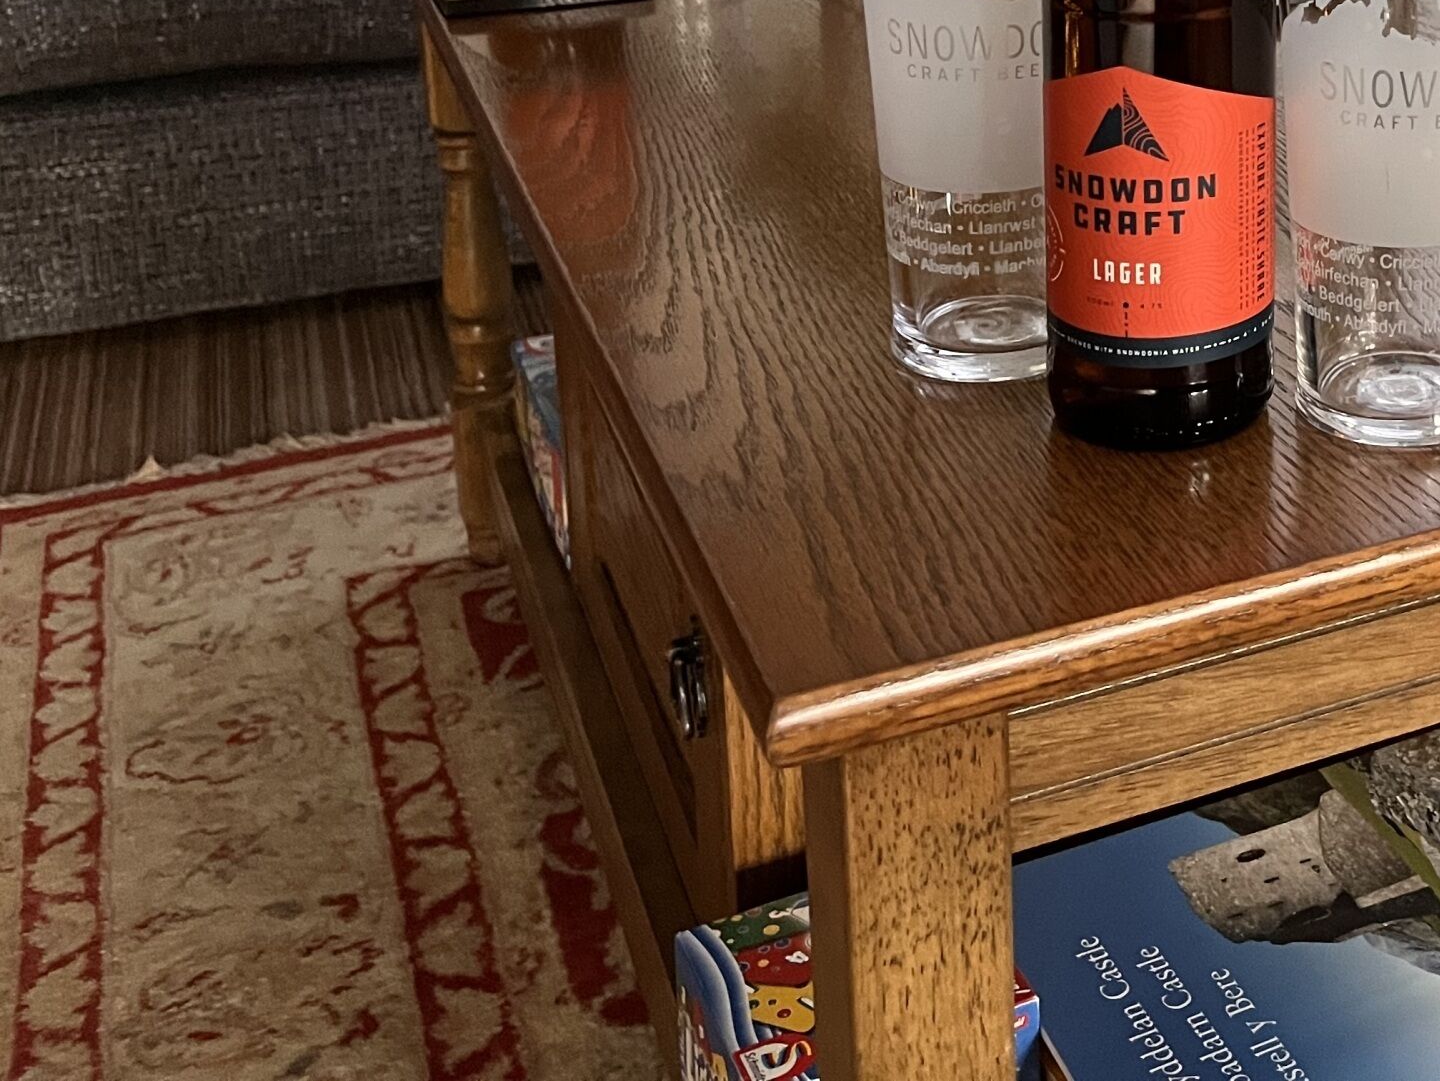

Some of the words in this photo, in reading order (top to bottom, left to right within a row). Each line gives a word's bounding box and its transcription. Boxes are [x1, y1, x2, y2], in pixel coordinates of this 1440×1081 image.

[907, 63, 978, 82] CRAFT
[1340, 109, 1418, 130] CRAFT
[1055, 162, 1217, 204] SNOWDON
[898, 190, 936, 215] Cowy
[951, 198, 1017, 215] Criccieth
[969, 217, 1036, 235] Llanrwst
[1073, 202, 1186, 236] CRAFT
[899, 230, 974, 257] Beddgelert
[1092, 258, 1162, 285] LAGER
[1319, 284, 1401, 313] Beddgelert
[1094, 345, 1114, 355] WITH
[1116, 347, 1169, 357] SNOWDONIA
[1172, 345, 1200, 355] WATER
[1075, 934, 1131, 1000] Castle
[1140, 945, 1193, 1010] Castle
[1210, 968, 1256, 1018] Bere
[1245, 1019, 1277, 1034] y
